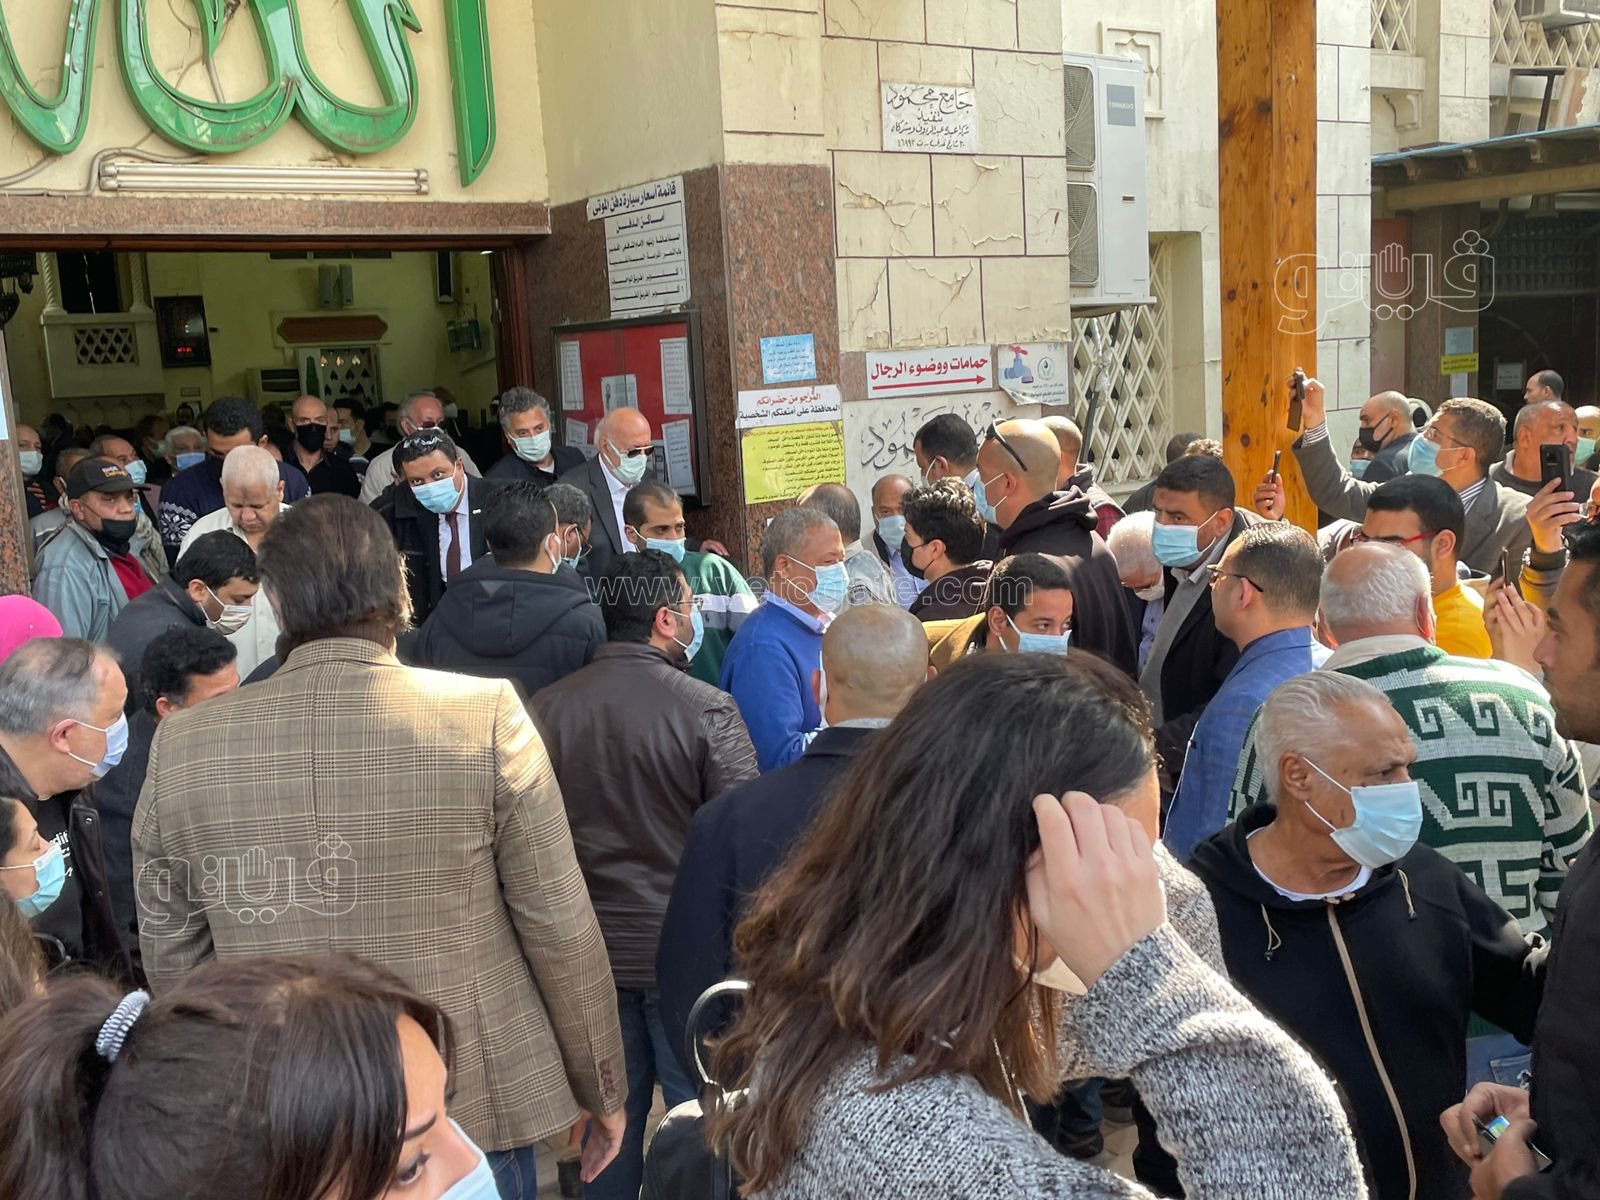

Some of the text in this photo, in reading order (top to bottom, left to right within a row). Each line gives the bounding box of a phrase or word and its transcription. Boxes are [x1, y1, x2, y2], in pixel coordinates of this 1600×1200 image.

[623, 193, 640, 209] سيارة
[871, 355, 988, 380] حمامات ووضوء الرجال
[757, 395, 788, 407] حضراتكم
[788, 394, 798, 405] من
[740, 408, 771, 421] الشخصية
[797, 407, 810, 417] على
[810, 404, 841, 413] المحافظة
